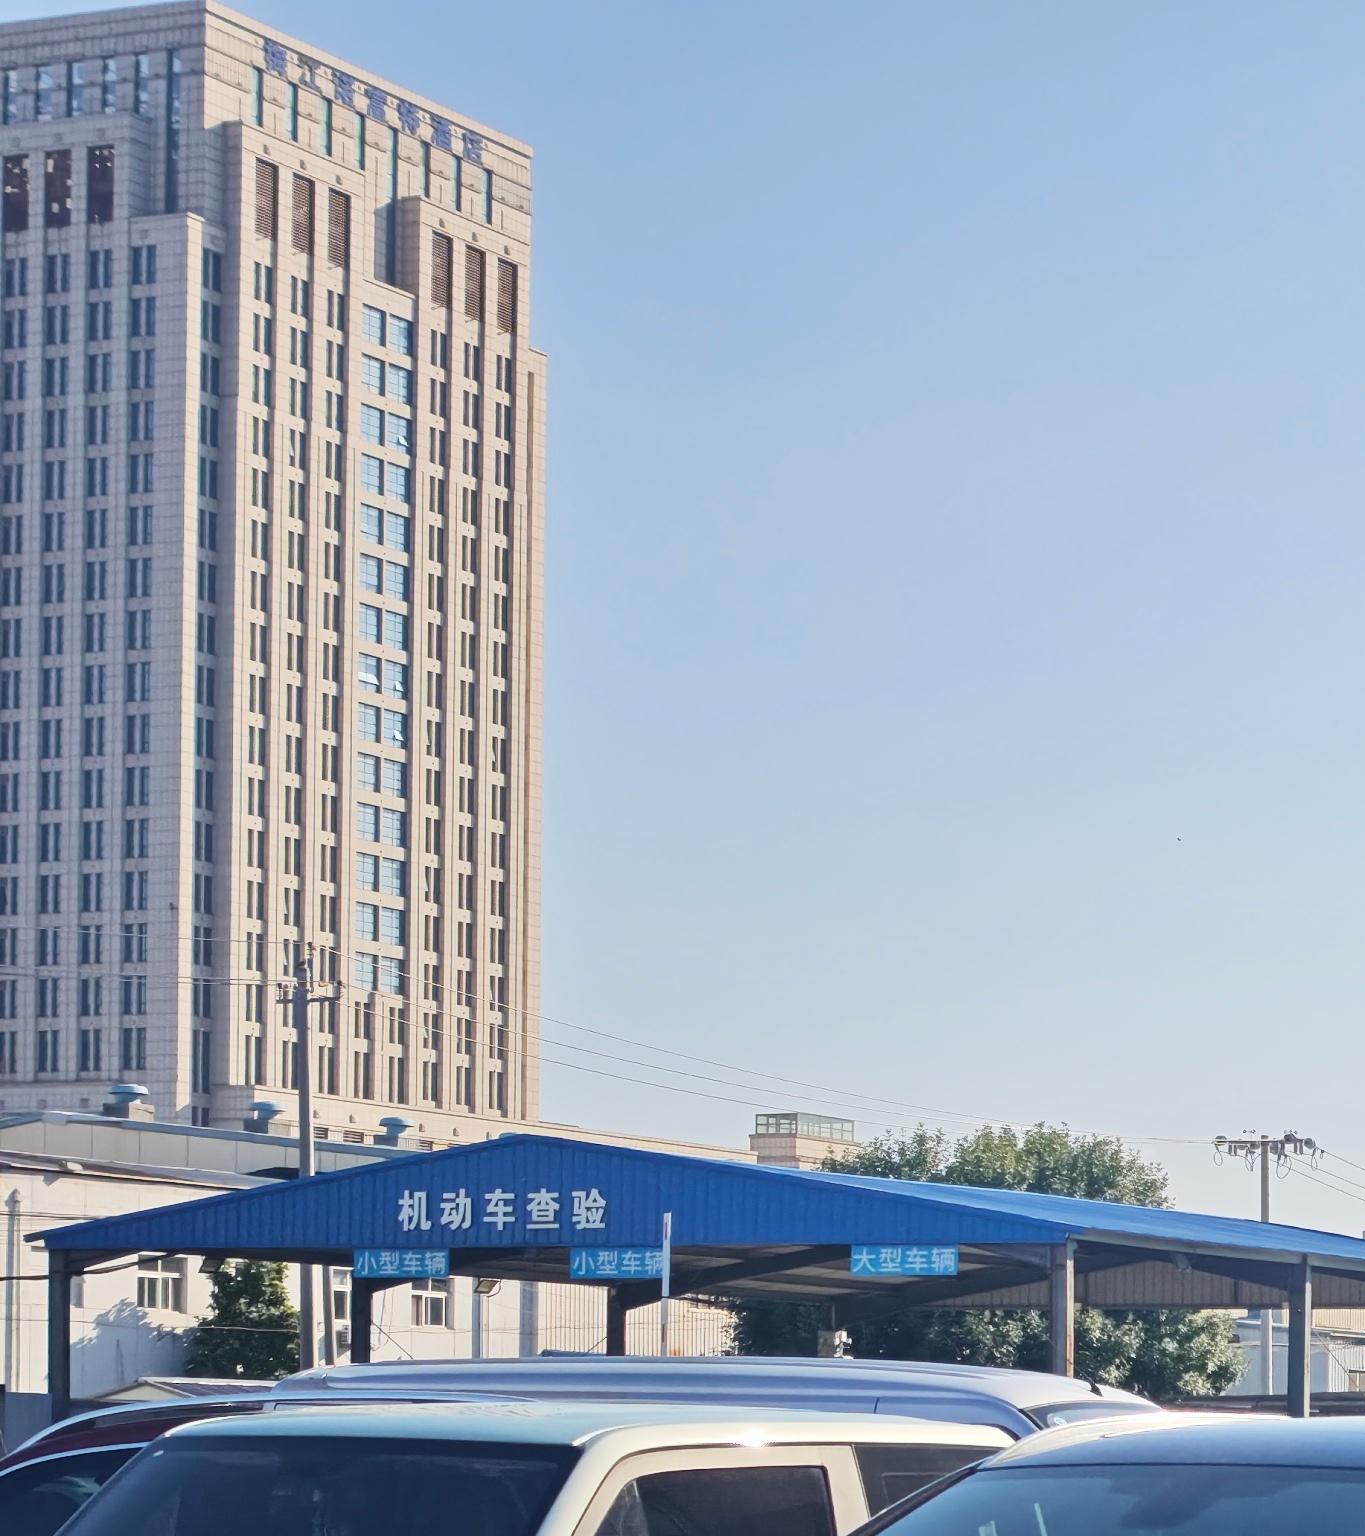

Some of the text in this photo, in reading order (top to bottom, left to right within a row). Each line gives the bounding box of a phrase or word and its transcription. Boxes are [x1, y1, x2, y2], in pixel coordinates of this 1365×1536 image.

[397, 1187, 607, 1232] 机动车查验
[357, 1250, 446, 1276] 小型车辆
[573, 1250, 664, 1275] 小型车辆
[852, 1247, 956, 1273] 大型车辆
